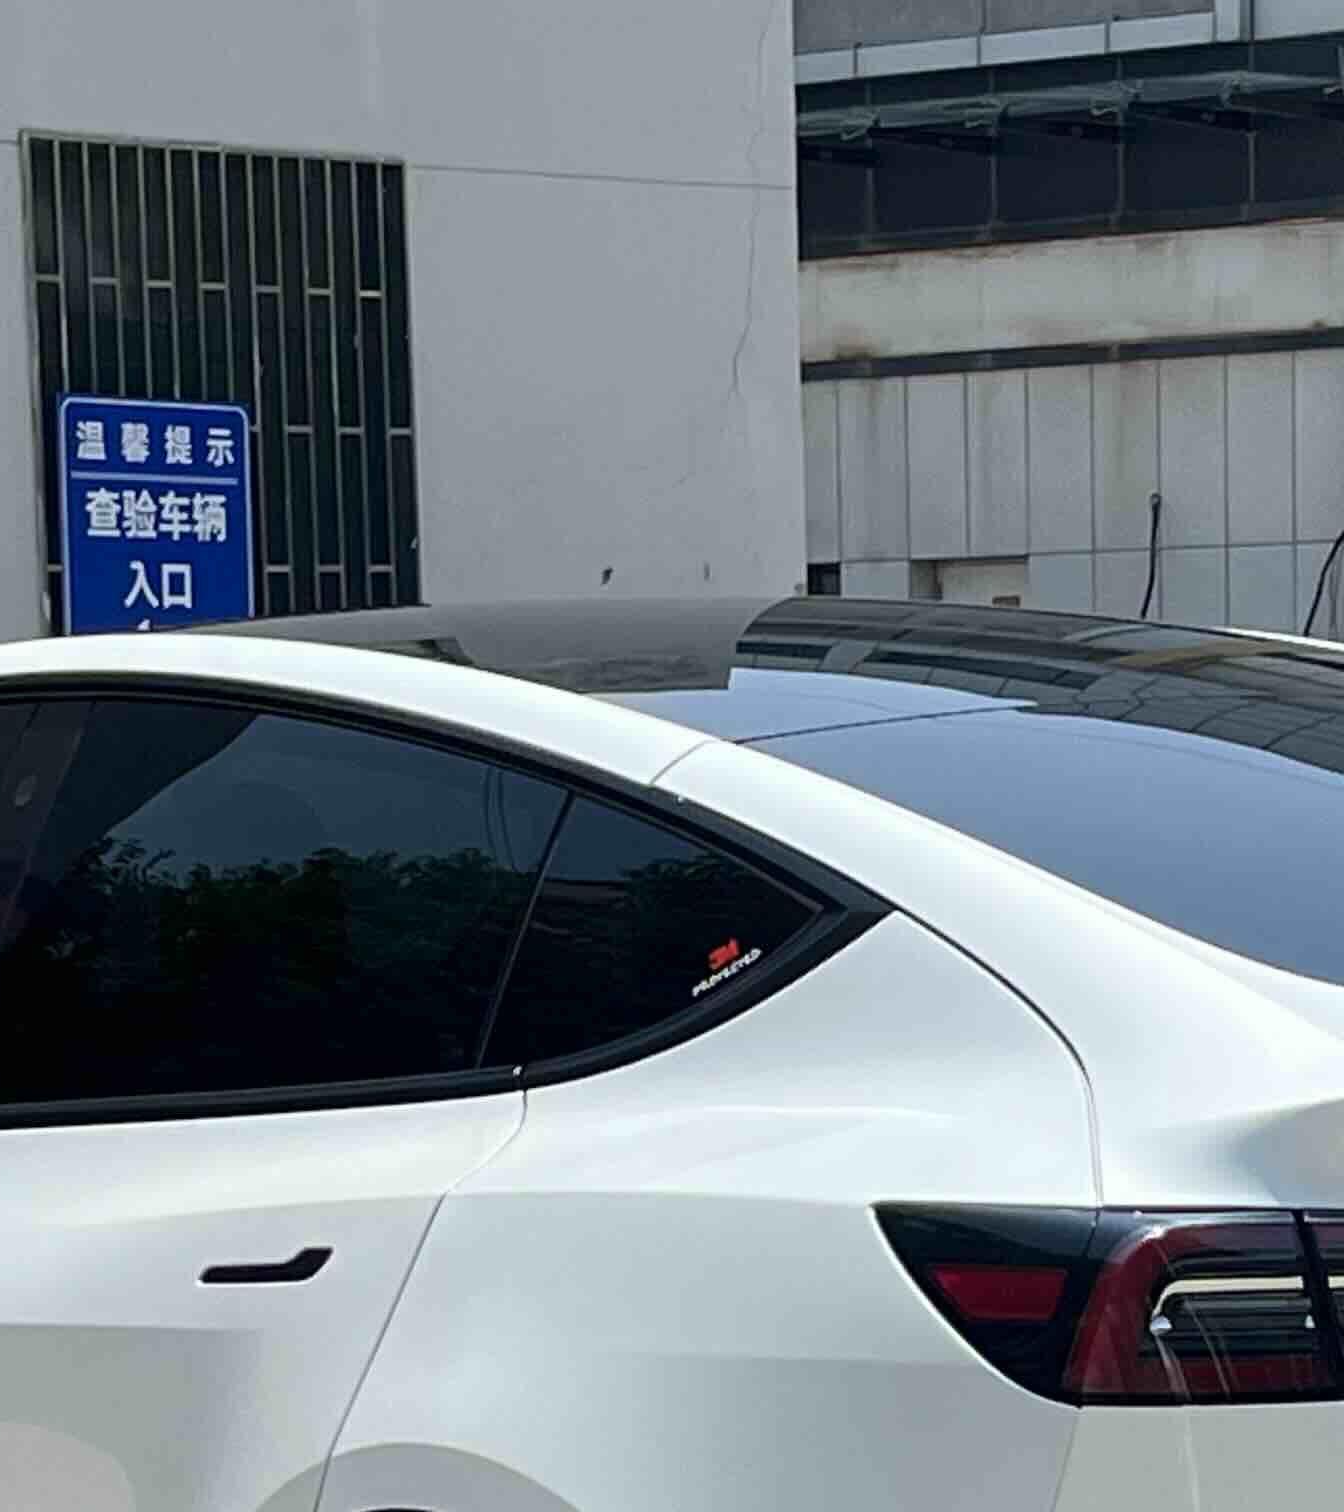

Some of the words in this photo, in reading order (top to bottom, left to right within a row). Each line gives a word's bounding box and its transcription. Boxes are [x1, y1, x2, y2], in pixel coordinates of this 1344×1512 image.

[75, 420, 235, 467] 温馨提示
[84, 487, 227, 543] 查验车辆
[124, 559, 193, 609] 入口
